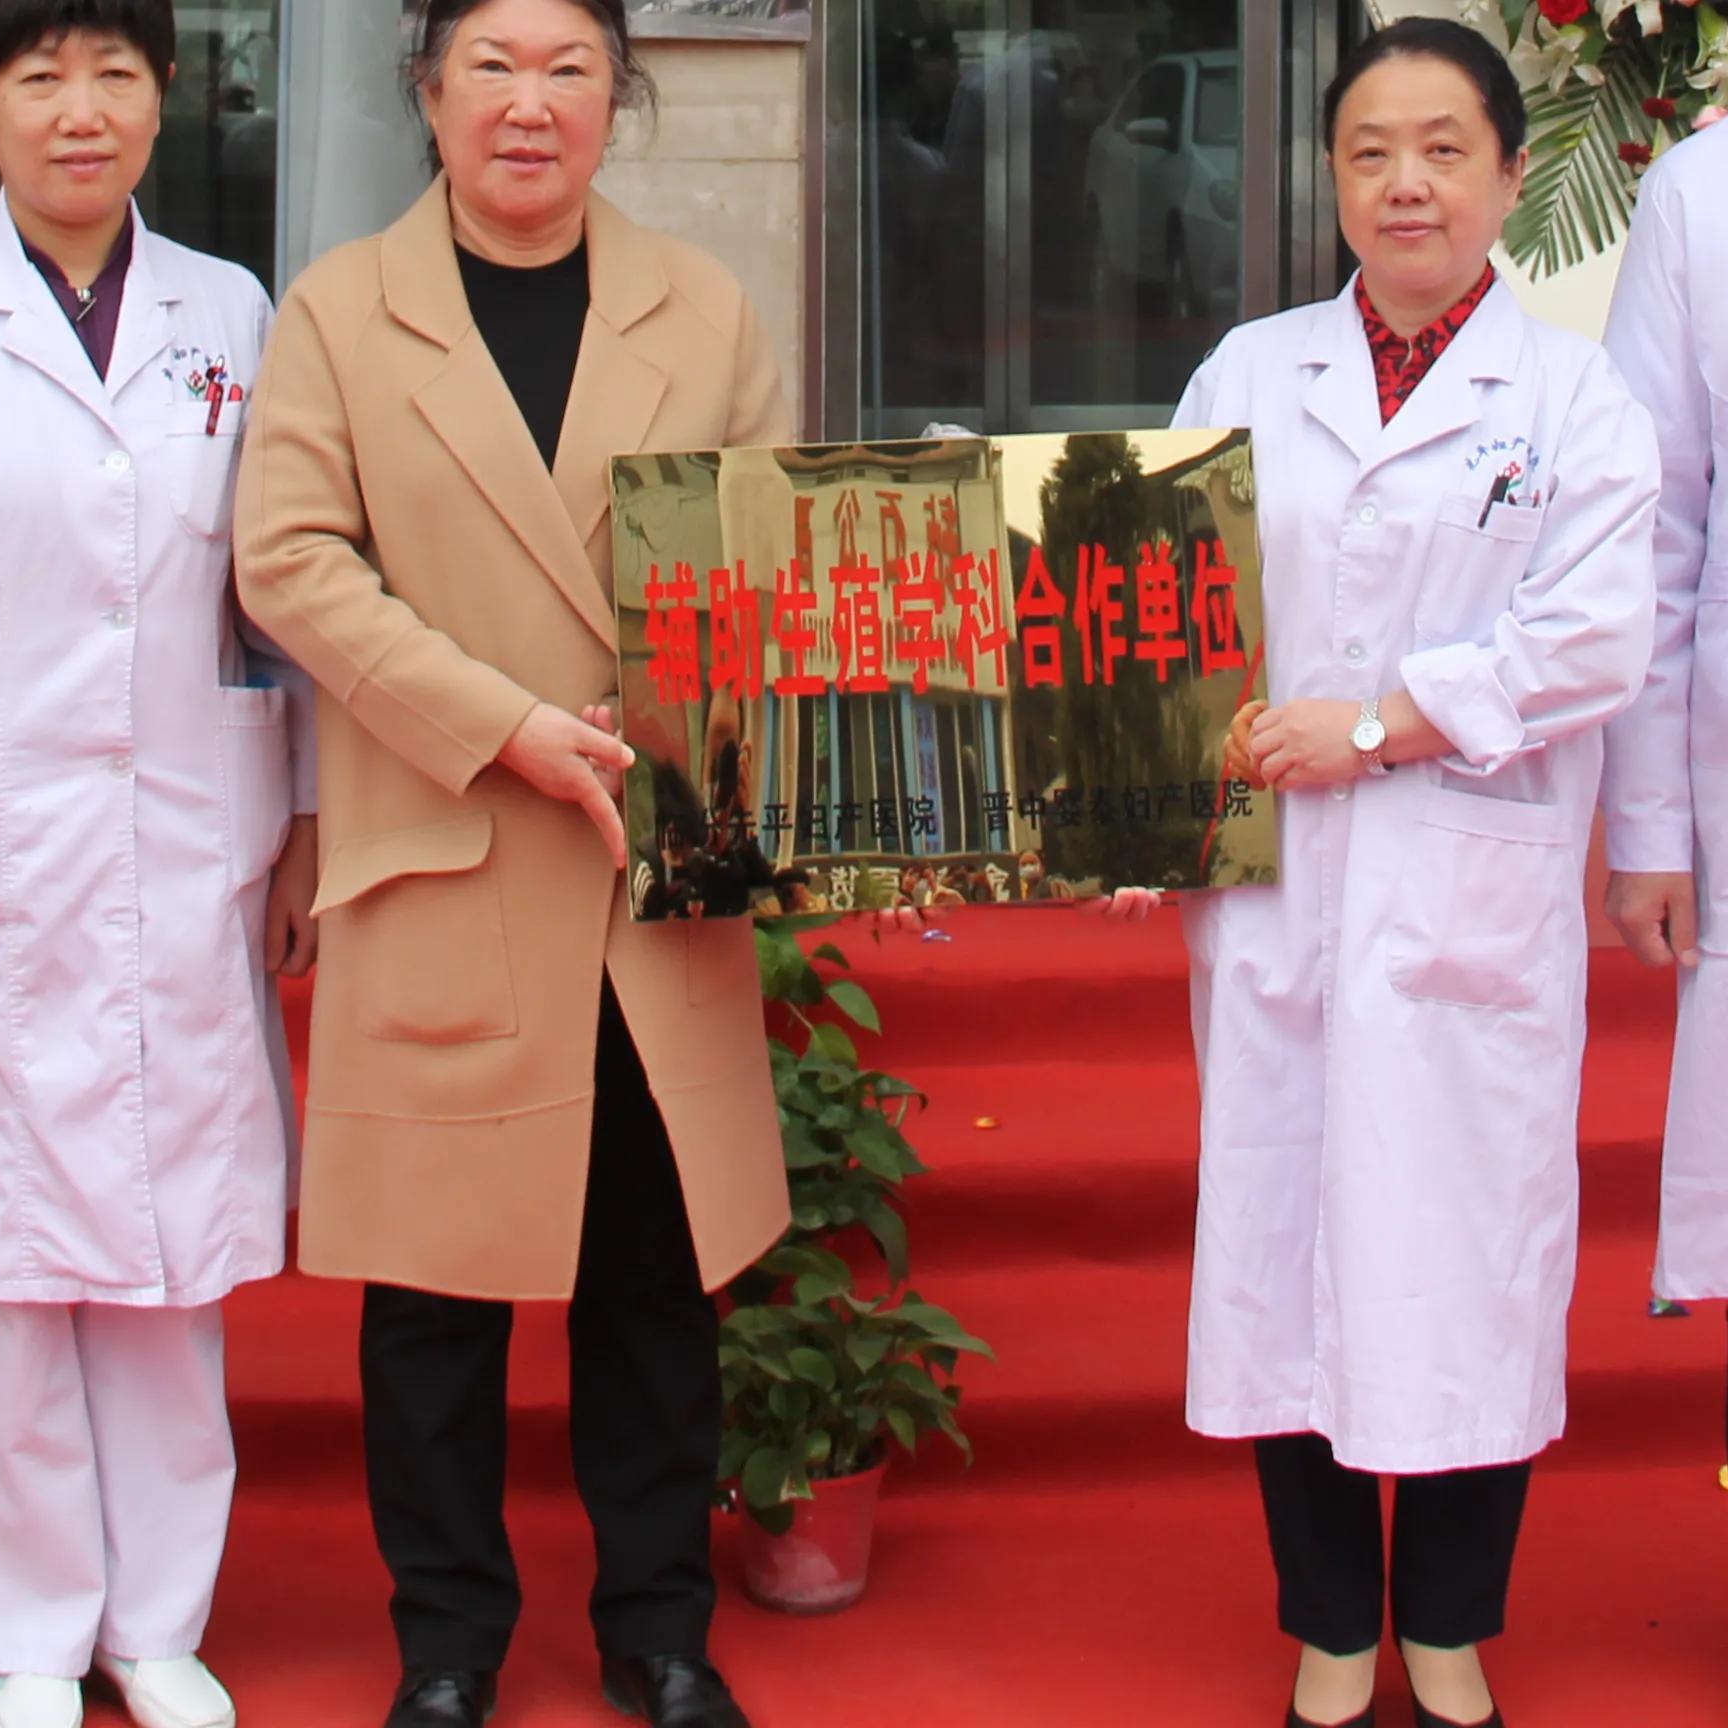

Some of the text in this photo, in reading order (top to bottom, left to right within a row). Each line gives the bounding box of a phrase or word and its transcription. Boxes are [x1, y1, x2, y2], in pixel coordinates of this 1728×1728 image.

[642, 537, 1246, 707] 辅助生殖学科合作单位
[981, 778, 1254, 832] 晋中婴泰妇产医院
